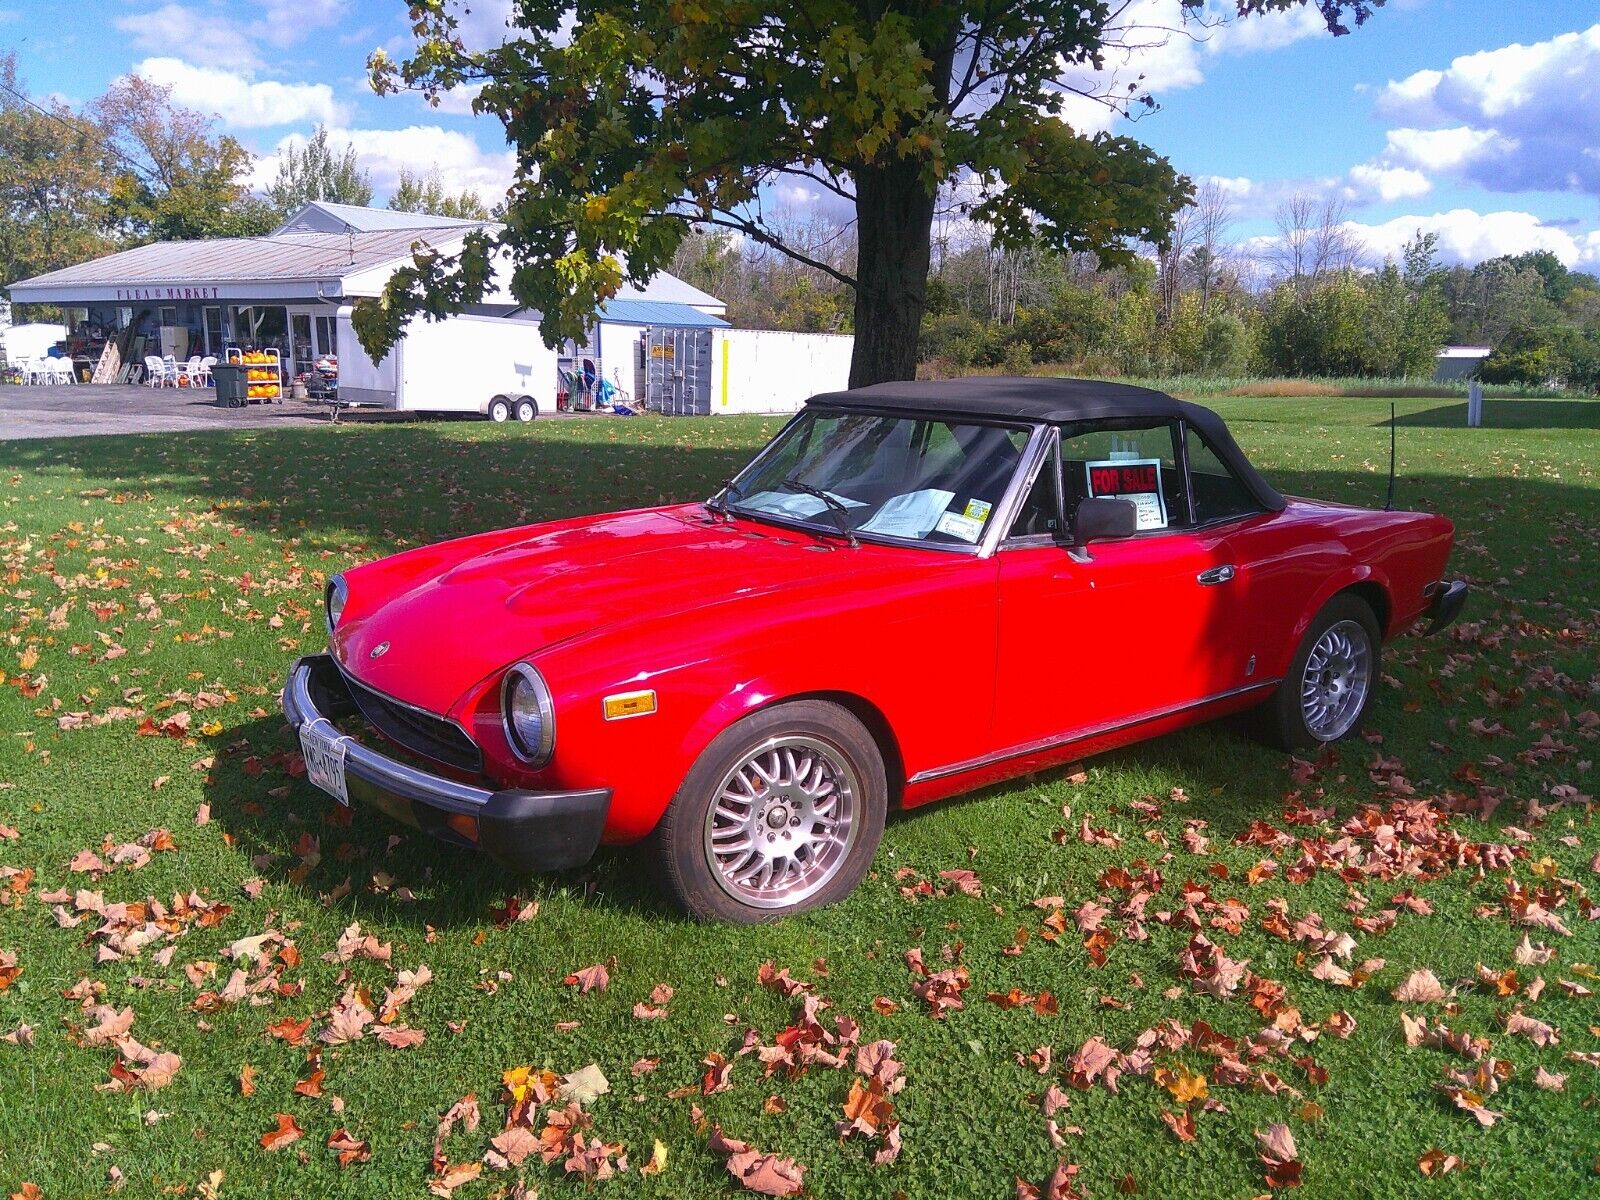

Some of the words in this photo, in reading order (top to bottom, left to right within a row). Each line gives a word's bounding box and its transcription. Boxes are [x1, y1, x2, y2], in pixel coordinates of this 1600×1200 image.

[117, 289, 150, 300] FLEA
[167, 287, 218, 300] MARKET
[1092, 468, 1119, 493] FOR
[1122, 466, 1156, 491] SALE
